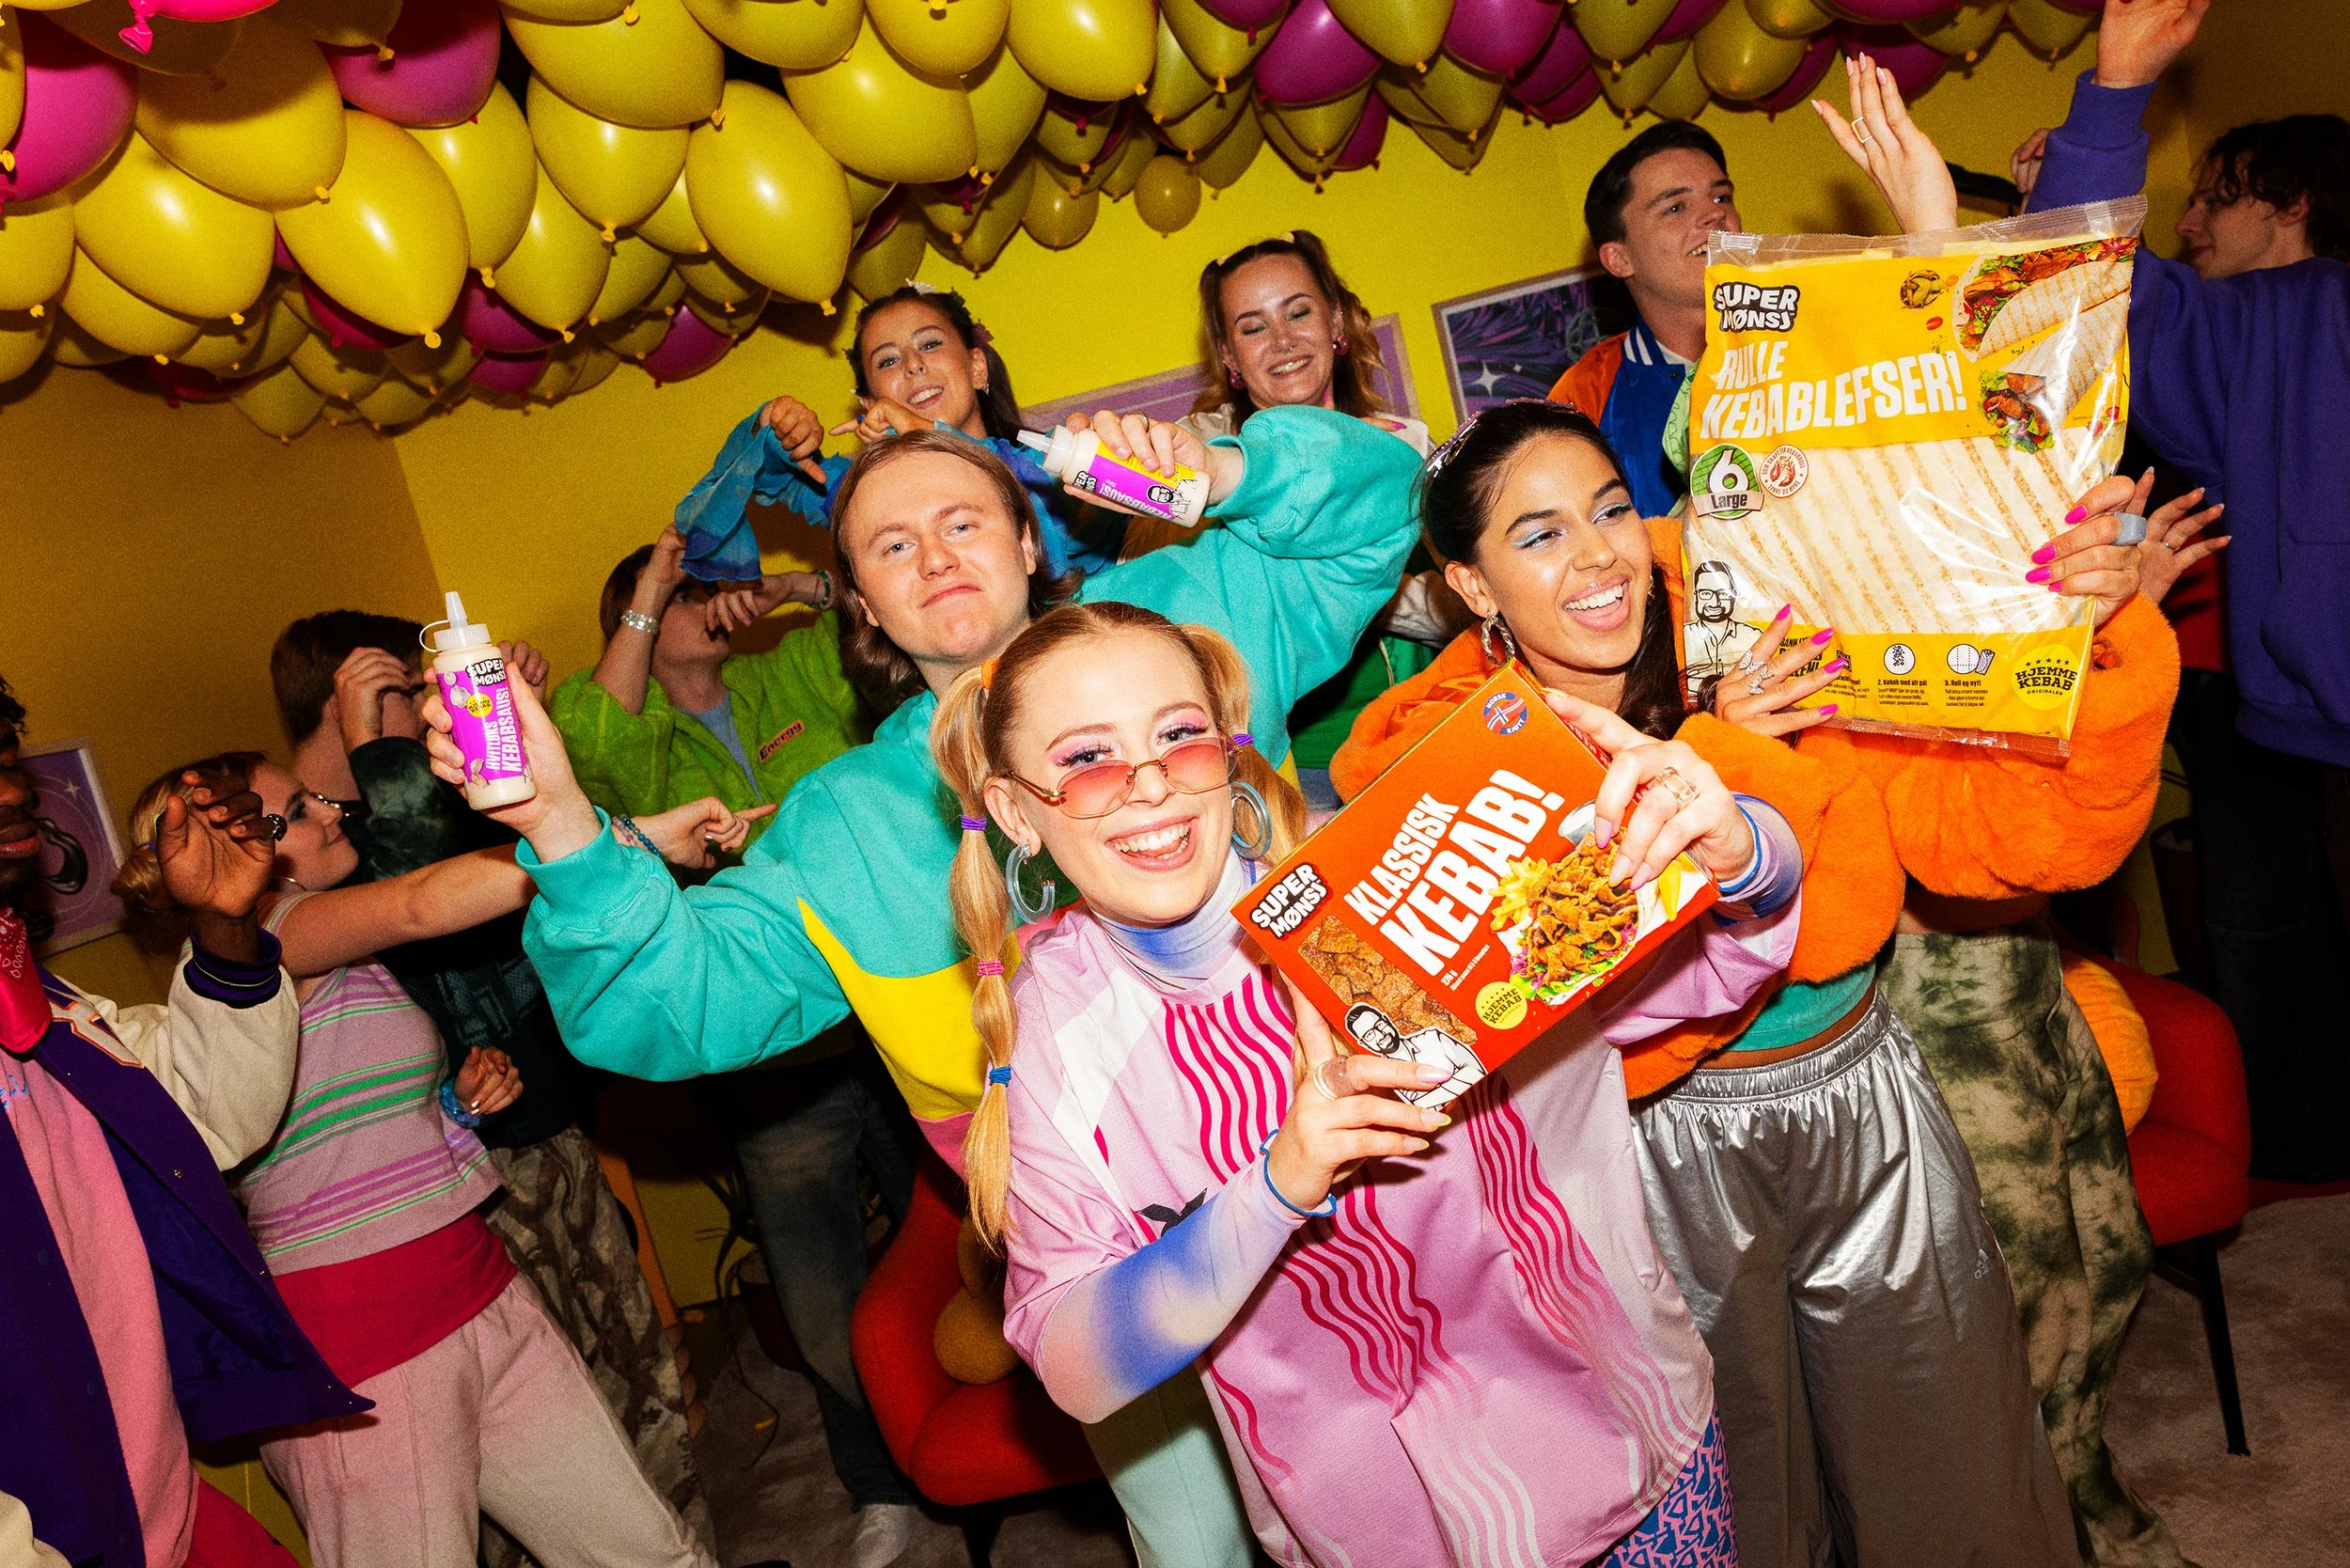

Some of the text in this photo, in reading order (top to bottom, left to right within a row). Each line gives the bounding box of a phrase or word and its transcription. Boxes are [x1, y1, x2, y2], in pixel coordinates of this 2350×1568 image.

[1716, 284, 1797, 310] SUPER
[1723, 308, 1791, 330] MØNSJ
[1716, 341, 1788, 389] RULLE
[1700, 352, 1966, 438] KEBABLEFSER!
[1707, 448, 1749, 494] 6
[1711, 494, 1747, 509] Large
[2015, 666, 2077, 681] HJEMME
[2018, 677, 2073, 691] KEBAB
[1485, 693, 1506, 709] NORSK
[495, 686, 523, 772] KEBABSAUS!
[759, 722, 802, 760] Energy
[1506, 718, 1525, 734] KJØTT
[485, 721, 501, 770] HVITLØKS
[1343, 792, 1460, 926] KLASSISK
[1379, 769, 1565, 977] KEBAB!
[1251, 864, 1319, 928] SUPER
[1269, 882, 1327, 938] MØNSJ
[1482, 988, 1518, 1020] HJEMME
[1489, 995, 1522, 1024] KEBAB
